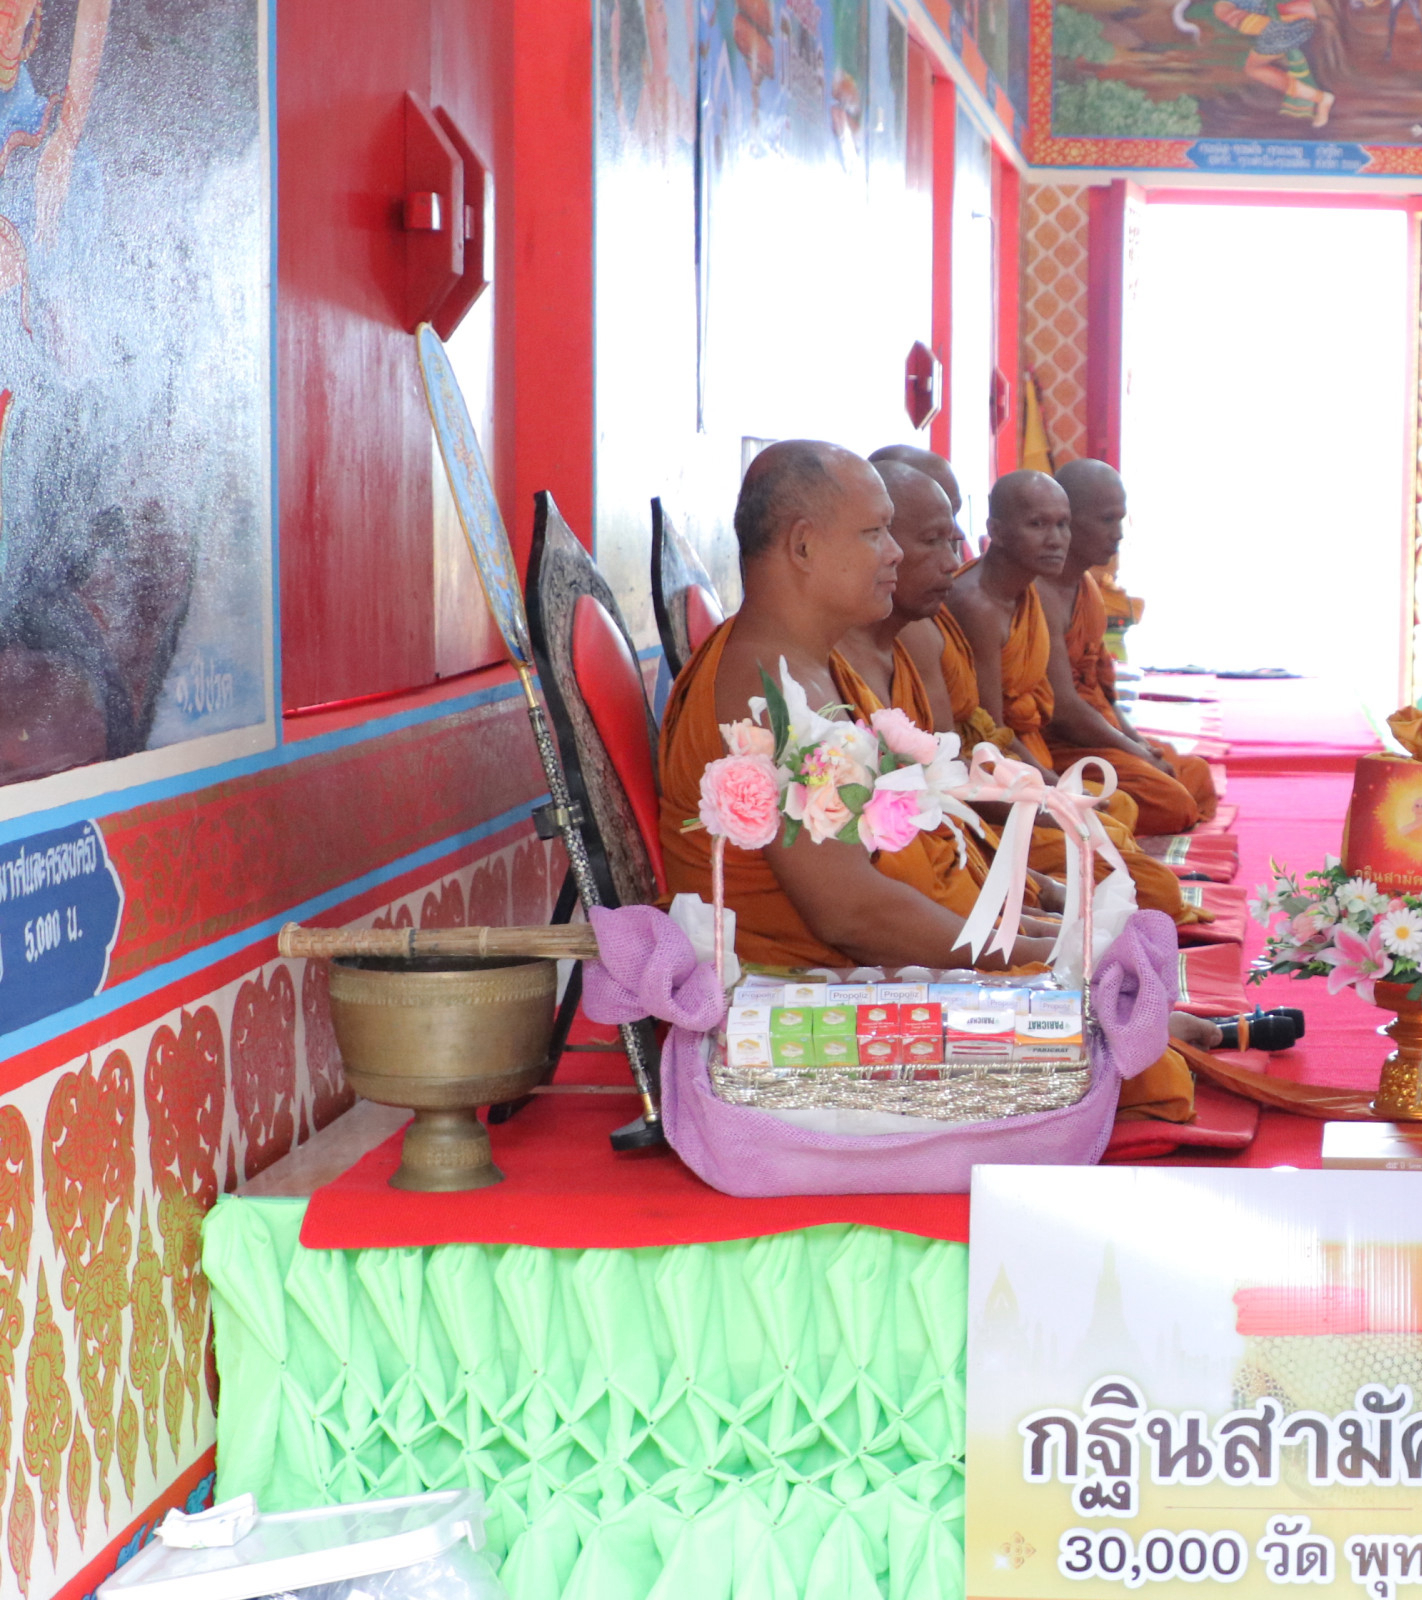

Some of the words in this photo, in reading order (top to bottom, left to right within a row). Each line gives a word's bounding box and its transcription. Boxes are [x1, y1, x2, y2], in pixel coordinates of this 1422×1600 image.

[24, 908, 61, 963] 5,000
[833, 990, 869, 1001] Propoliz
[883, 990, 919, 1001] Propoliz
[1028, 1020, 1064, 1030] PARICHAT
[1066, 1536, 1240, 1581] 30,000
[1267, 1522, 1327, 1577] วัด
